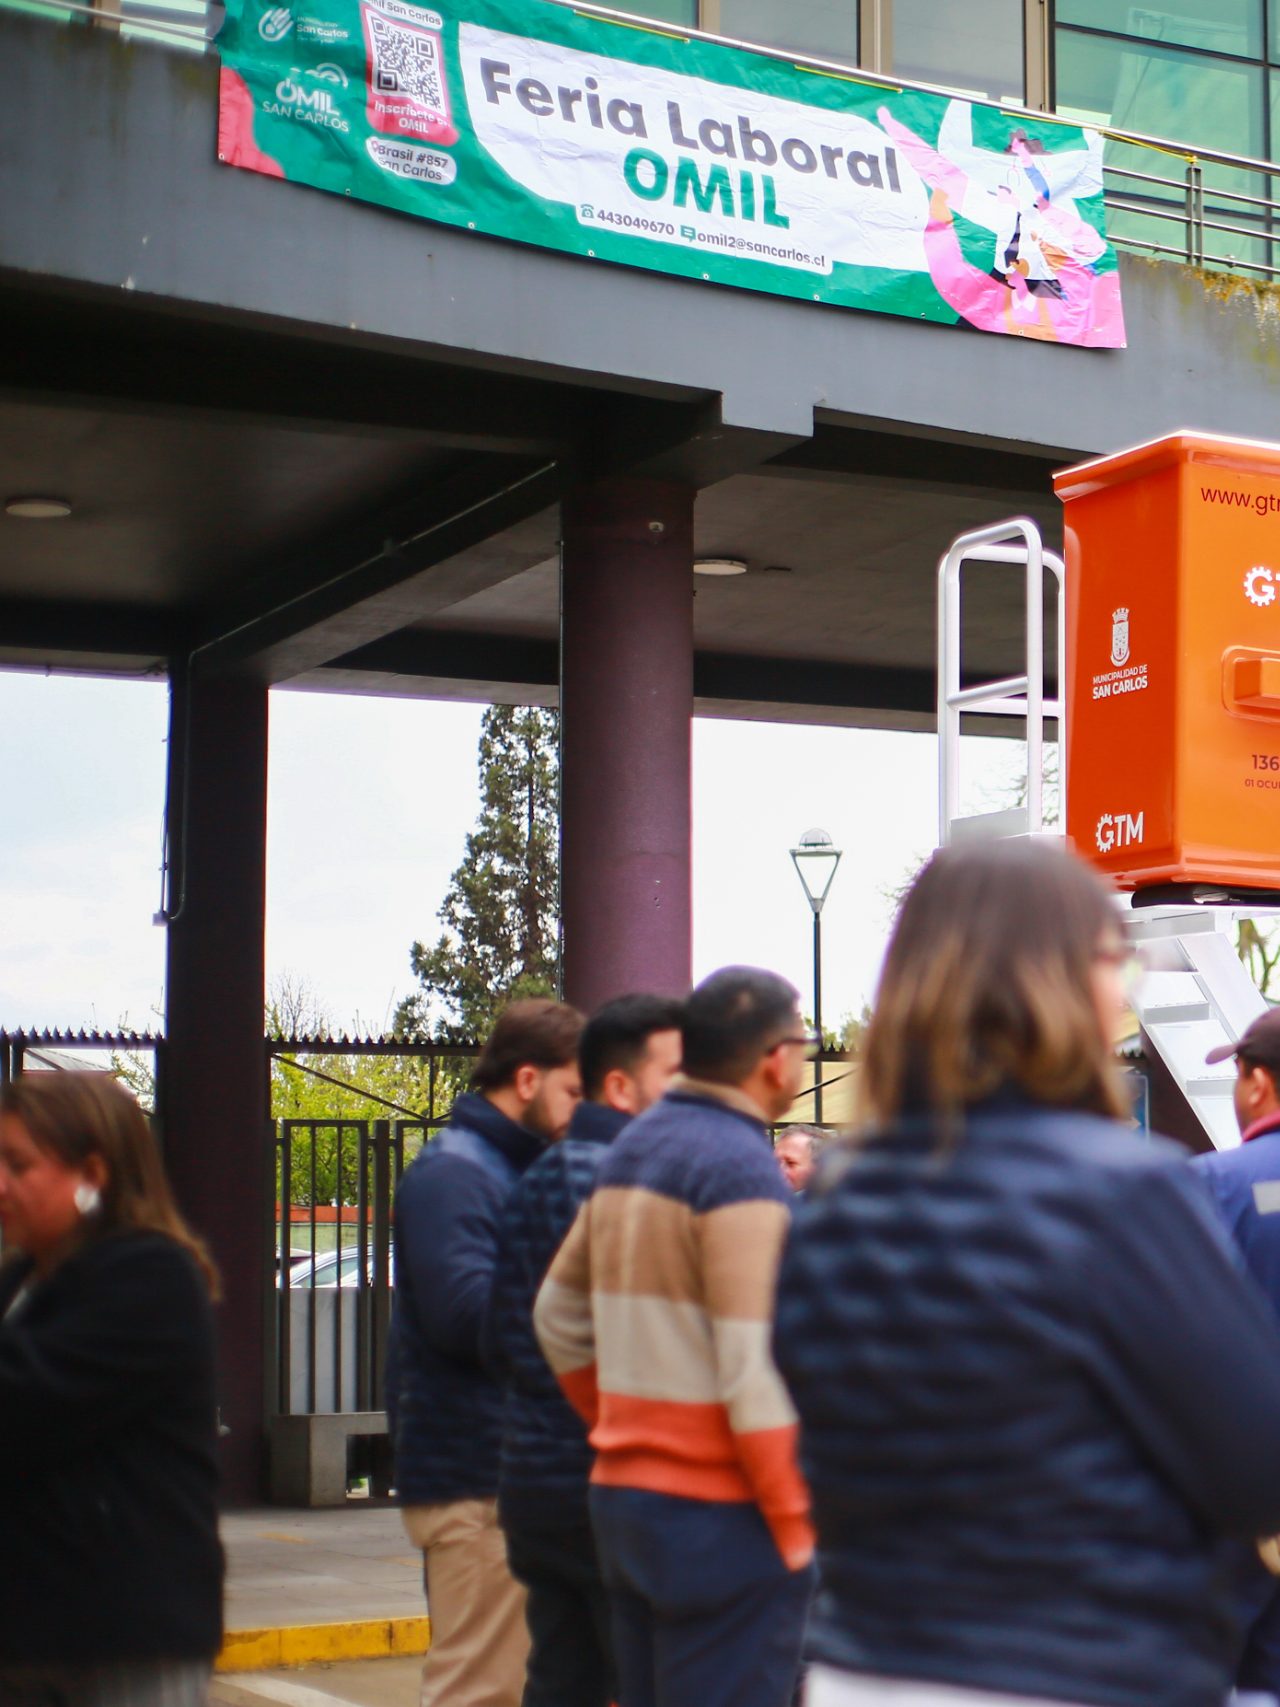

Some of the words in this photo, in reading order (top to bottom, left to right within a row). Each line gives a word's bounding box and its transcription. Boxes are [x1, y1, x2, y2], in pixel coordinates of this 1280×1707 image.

[387, 1, 406, 15] San
[408, 9, 441, 26] Carlos
[276, 78, 340, 116] OMIL
[263, 100, 291, 118] SAN
[295, 109, 349, 132] CARLOS
[398, 117, 429, 133] OMIL
[480, 57, 648, 139] Feria
[667, 100, 902, 194] Laboral
[378, 145, 413, 161] Brasil
[416, 152, 449, 168] #857
[402, 163, 442, 180] Carlos
[624, 147, 790, 229] OMIL
[597, 209, 675, 236] 443049670
[697, 231, 825, 267] omil2@sancarlos.cl
[1093, 666, 1138, 685] MUNICIPALIDAD
[1139, 664, 1148, 674] DE
[1093, 684, 1111, 700] SAN
[1112, 675, 1148, 695] CARLOS
[1095, 812, 1144, 853] GTM
